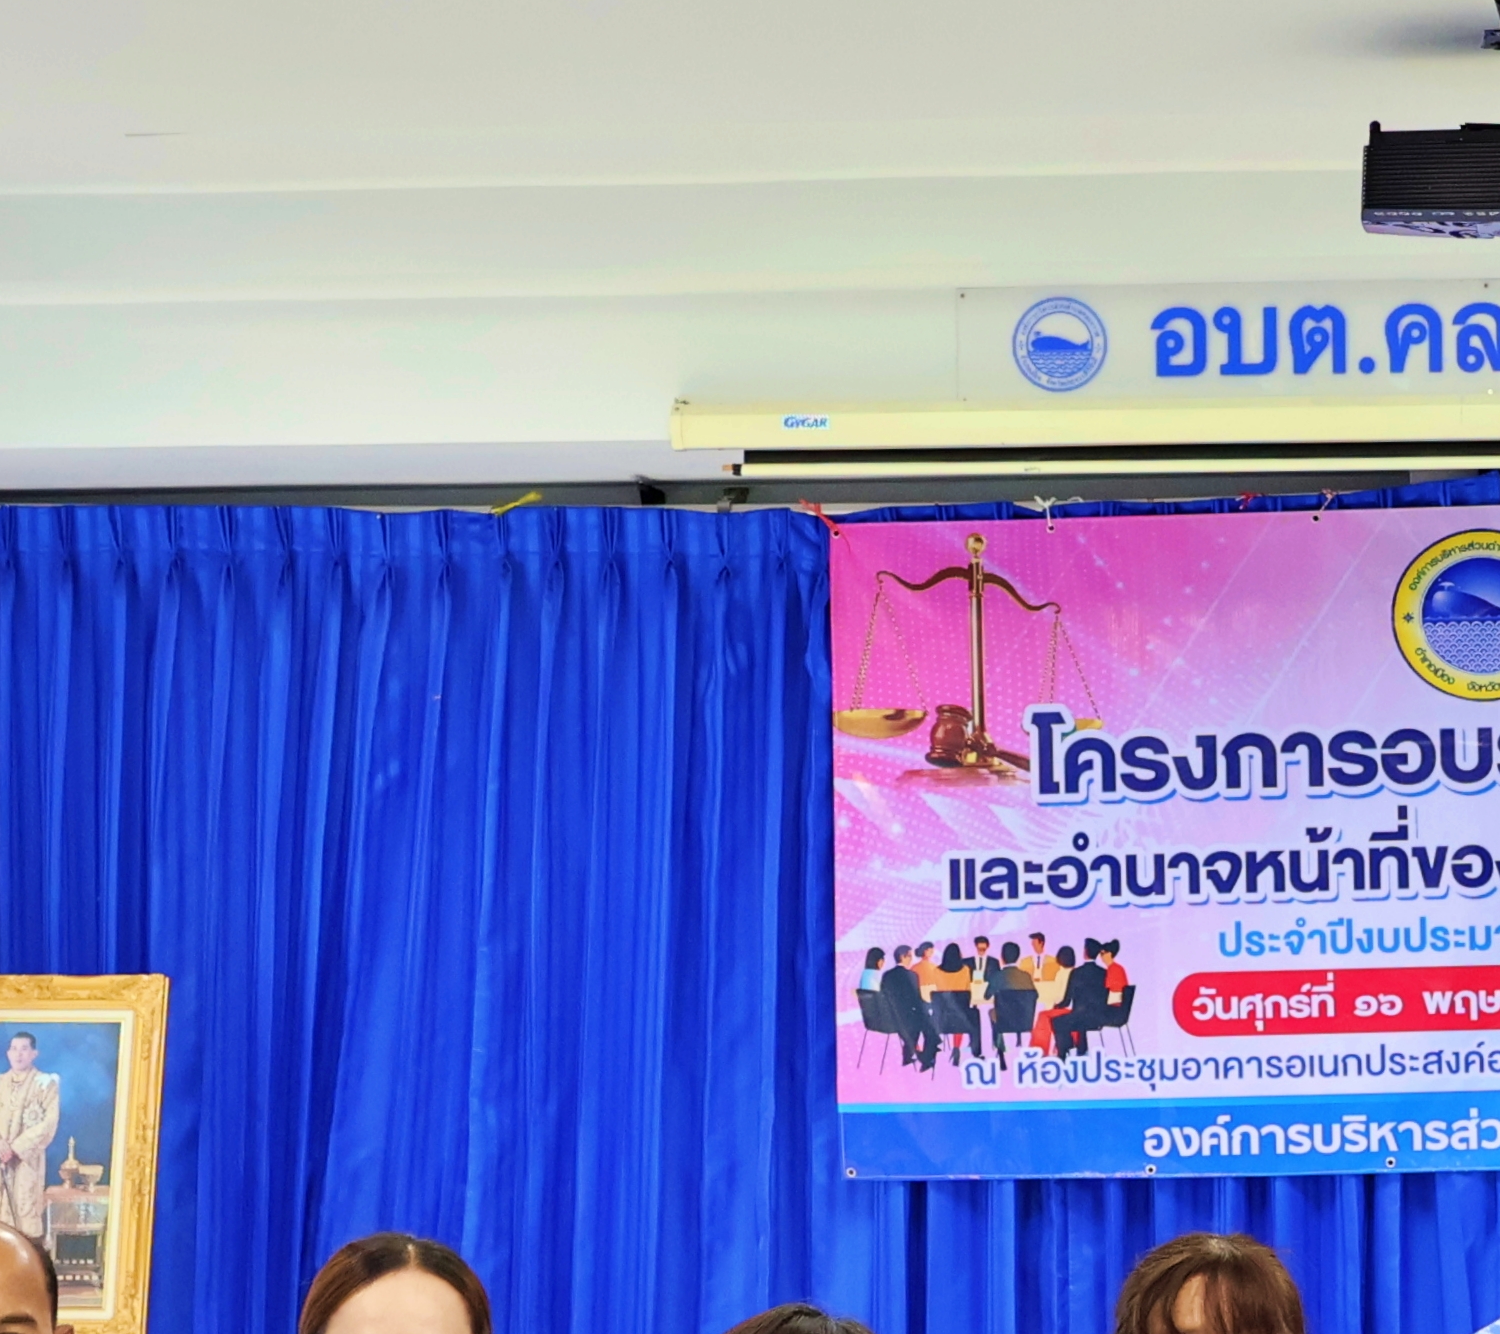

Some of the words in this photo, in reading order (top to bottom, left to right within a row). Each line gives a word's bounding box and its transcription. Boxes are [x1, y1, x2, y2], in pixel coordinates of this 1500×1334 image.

[1192, 973, 1337, 1031] วันศุกร์ที่
[1353, 995, 1405, 1018] ๑๖
[964, 1062, 996, 1086] ณ
